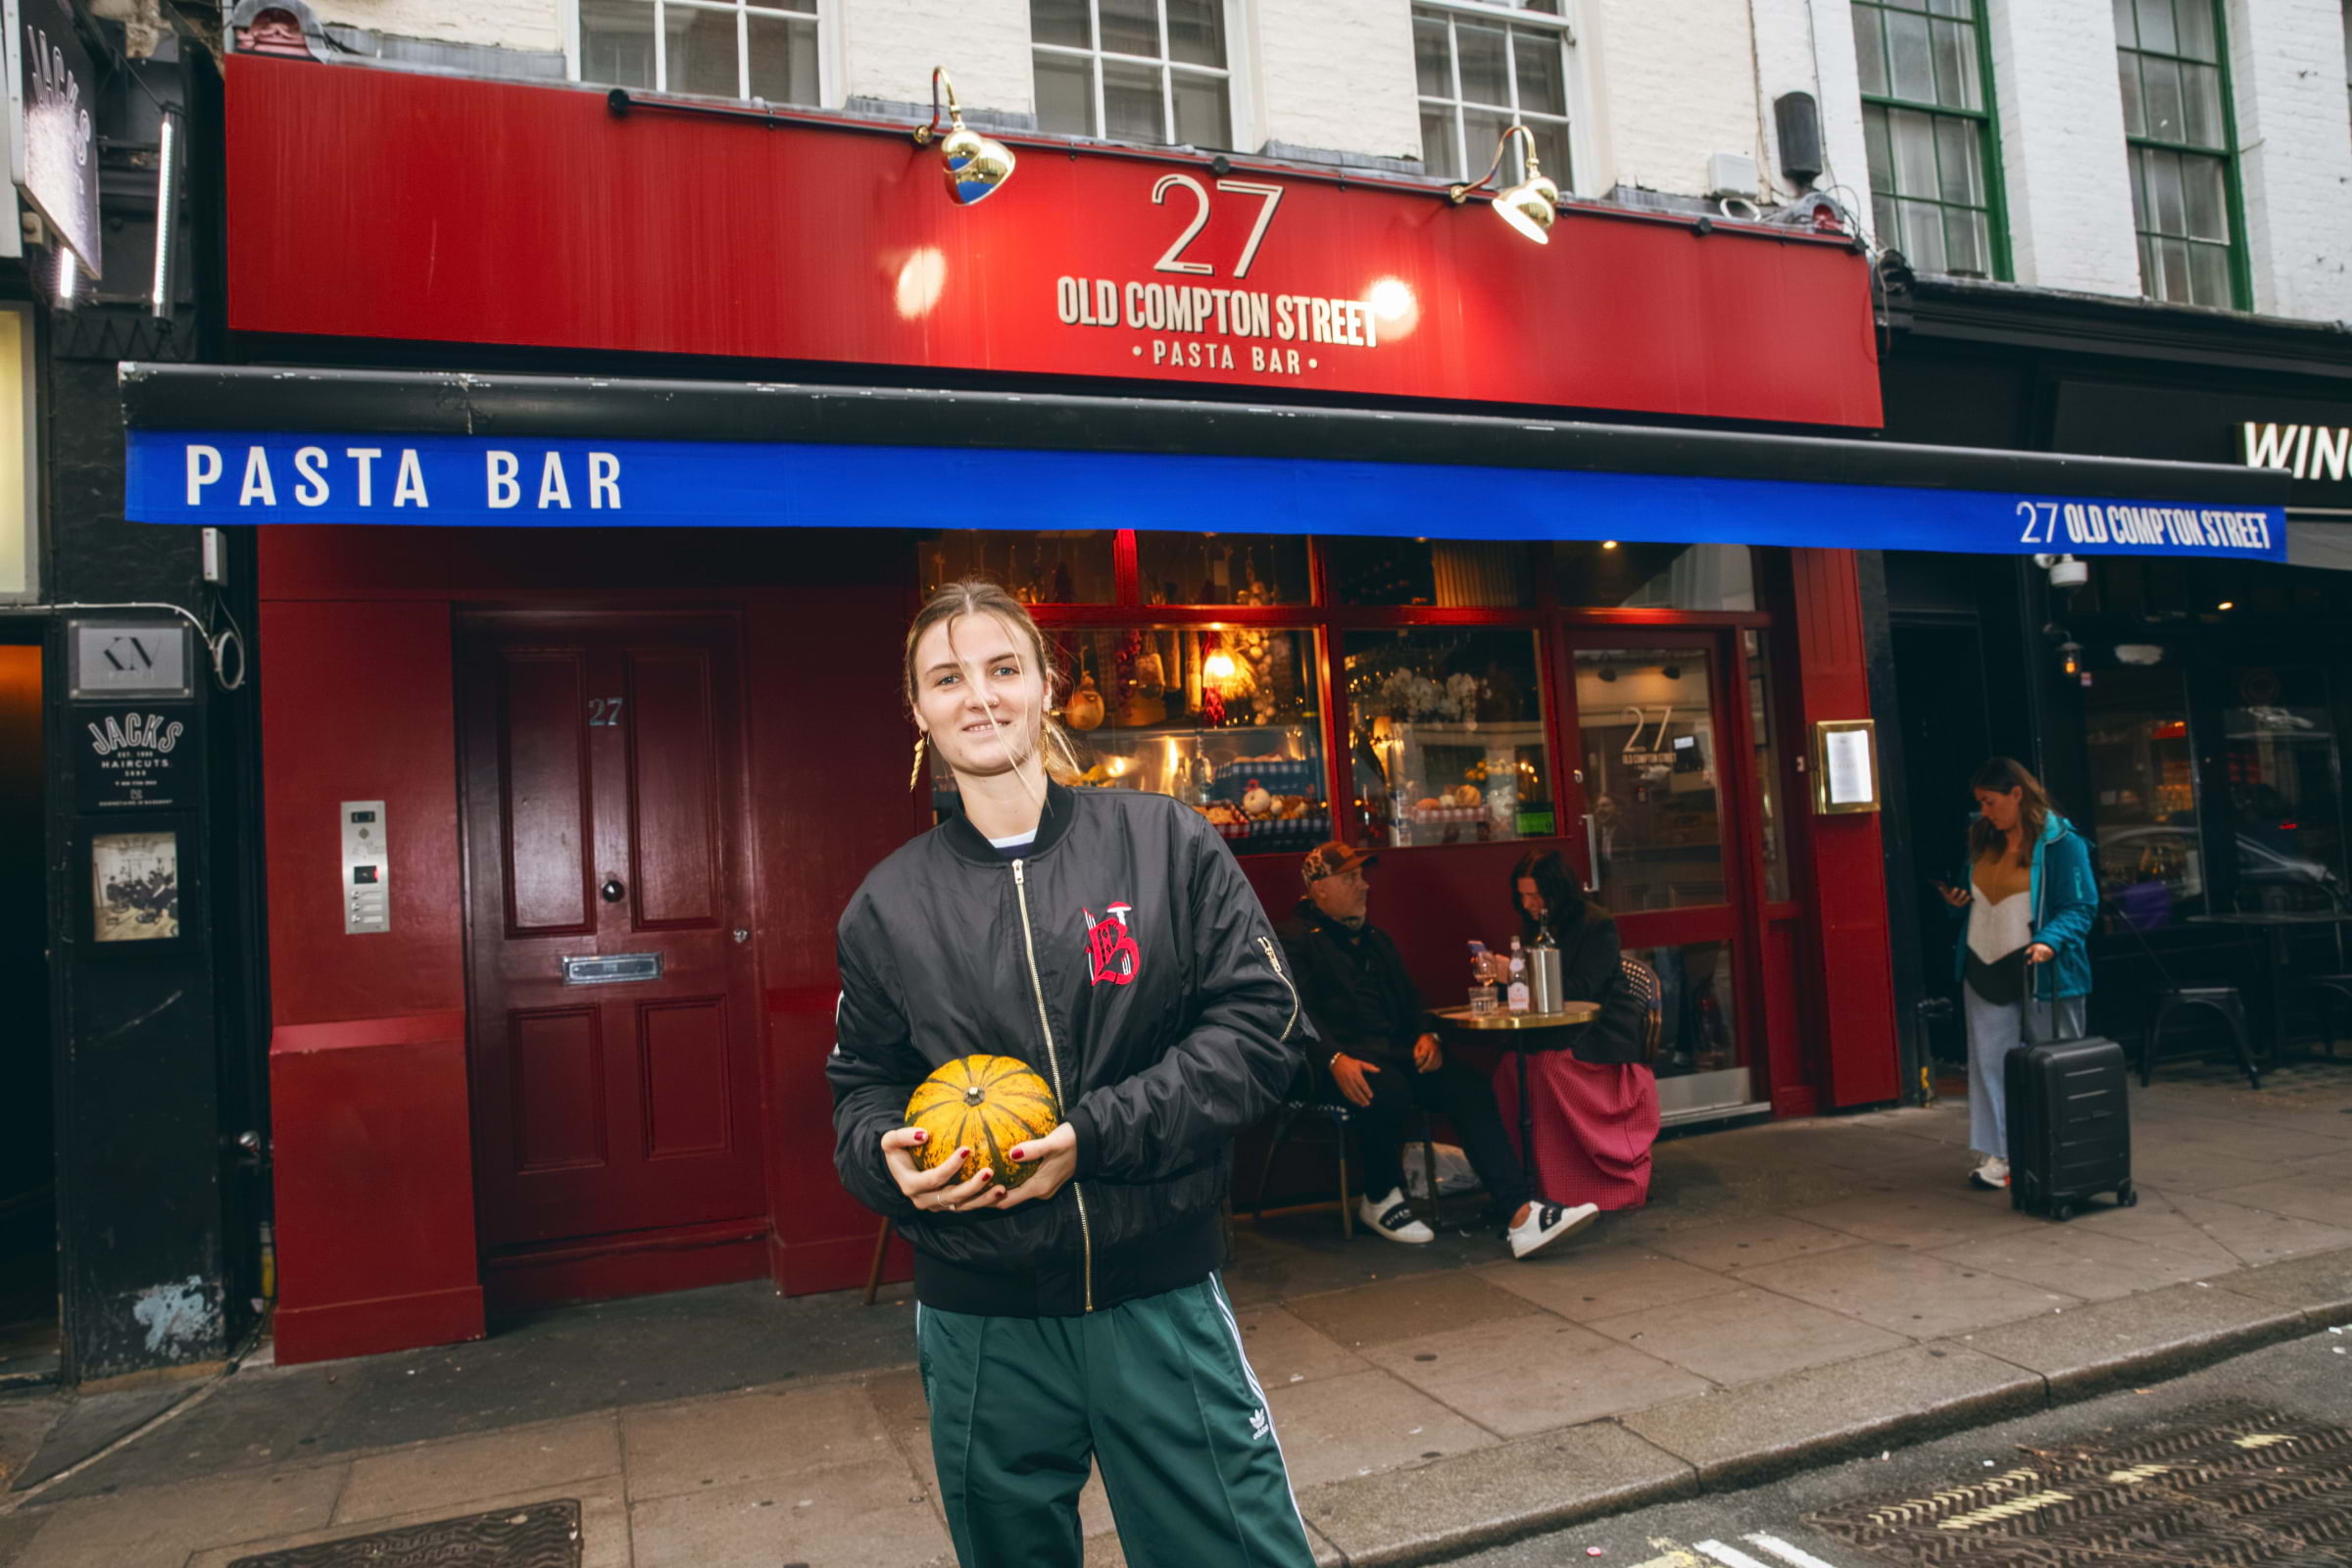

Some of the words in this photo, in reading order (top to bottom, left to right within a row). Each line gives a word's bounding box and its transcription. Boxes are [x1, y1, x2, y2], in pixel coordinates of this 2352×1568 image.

[1152, 173, 1285, 278] 27
[1056, 275, 1119, 326] OLD
[1125, 281, 1272, 338] COMPTON
[1276, 293, 1377, 348] STREET
[1152, 339, 1235, 370] PASTA
[1251, 346, 1300, 375] BAR
[2243, 421, 2352, 481] WIN
[185, 444, 429, 508] PASTA
[486, 450, 622, 510] BAR
[2016, 501, 2059, 543] 27
[2063, 503, 2109, 544] OLD
[2106, 506, 2206, 546] COMPTON
[2204, 510, 2272, 549] STREET
[88, 712, 184, 756] JACKS
[588, 698, 623, 726] 27
[1622, 706, 1673, 753] 27
[101, 759, 170, 768] HAIRCUTS
